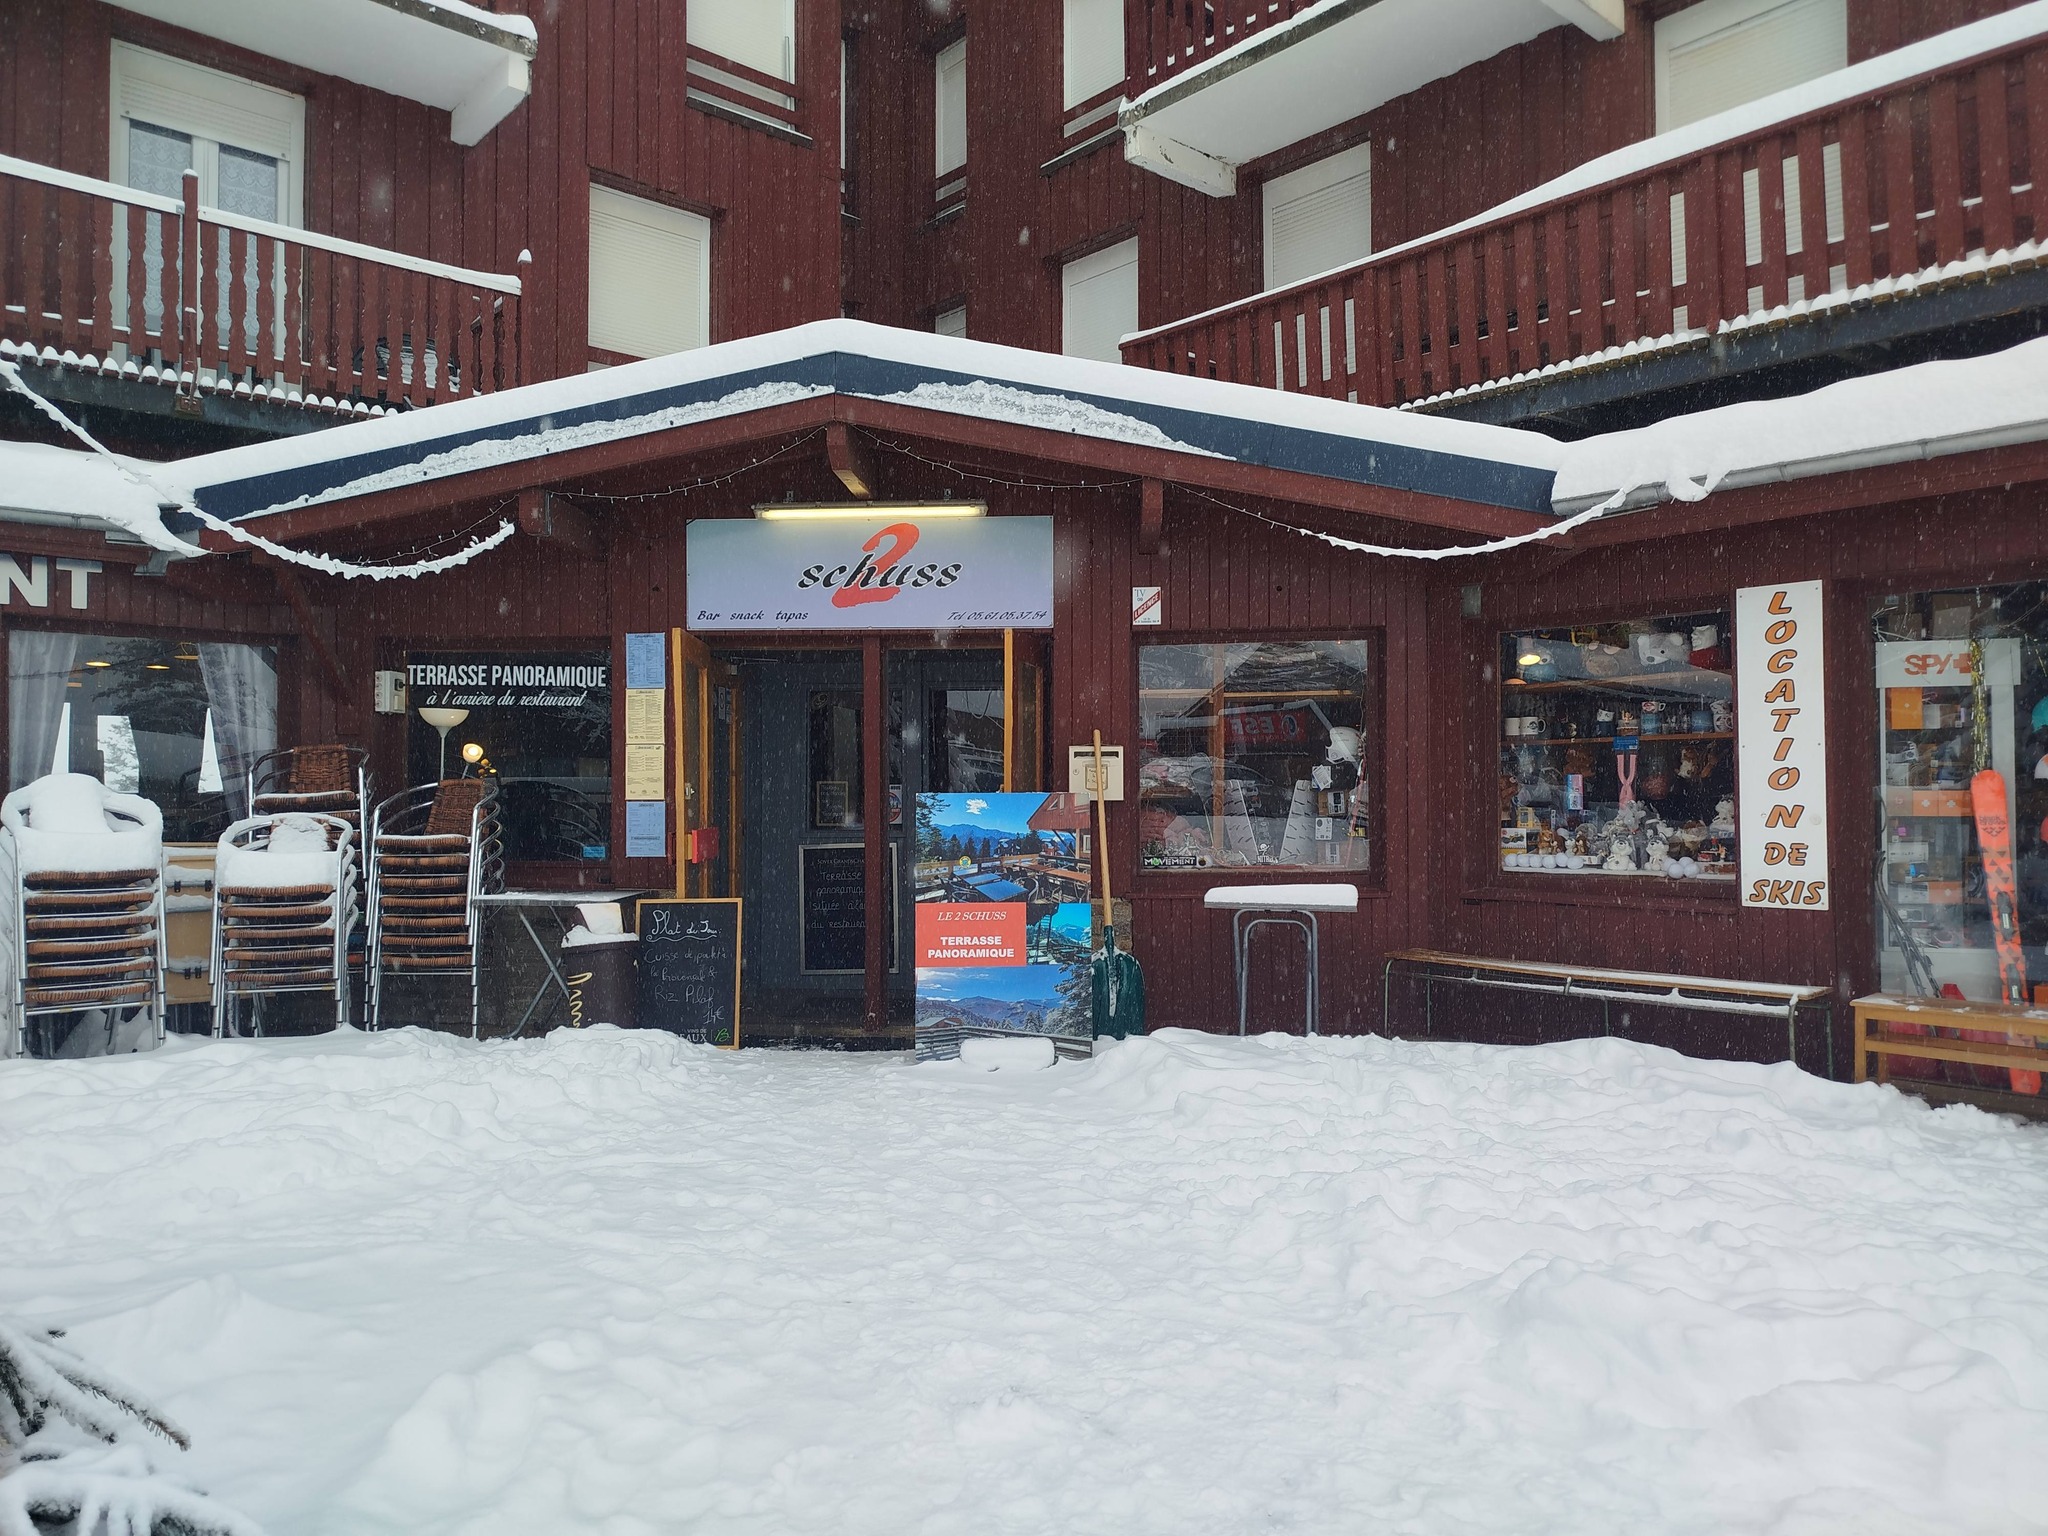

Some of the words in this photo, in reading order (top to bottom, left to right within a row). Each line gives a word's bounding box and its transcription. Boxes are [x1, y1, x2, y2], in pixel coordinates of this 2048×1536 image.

[797, 551, 964, 590] schuss
[831, 522, 920, 609] 2
[697, 610, 720, 621] Bar
[729, 609, 764, 621] snack
[775, 609, 809, 623] tapas
[947, 611, 966, 620] Tel
[967, 610, 1048, 621] 05.61.05.37.54
[1904, 653, 1953, 675] SPY
[407, 664, 488, 686] TERRASSE
[491, 665, 607, 688] PANORAMIQUE
[426, 691, 437, 705] à
[442, 689, 495, 705] l'arrière
[497, 691, 516, 706] du
[517, 691, 586, 707] restaurant
[1765, 591, 1804, 829] LOCATION
[1144, 857, 1195, 866] MOVEMENT
[1764, 842, 1808, 867] DE
[1749, 878, 1826, 906] SKIS
[651, 909, 681, 935] Plat
[937, 911, 953, 921] LE
[954, 911, 961, 921] 2
[962, 911, 1007, 921] SCHUSS
[940, 936, 1002, 946] TERRASSE
[643, 948, 679, 963] Cuisse
[927, 948, 1015, 959] PANORAMIQUE
